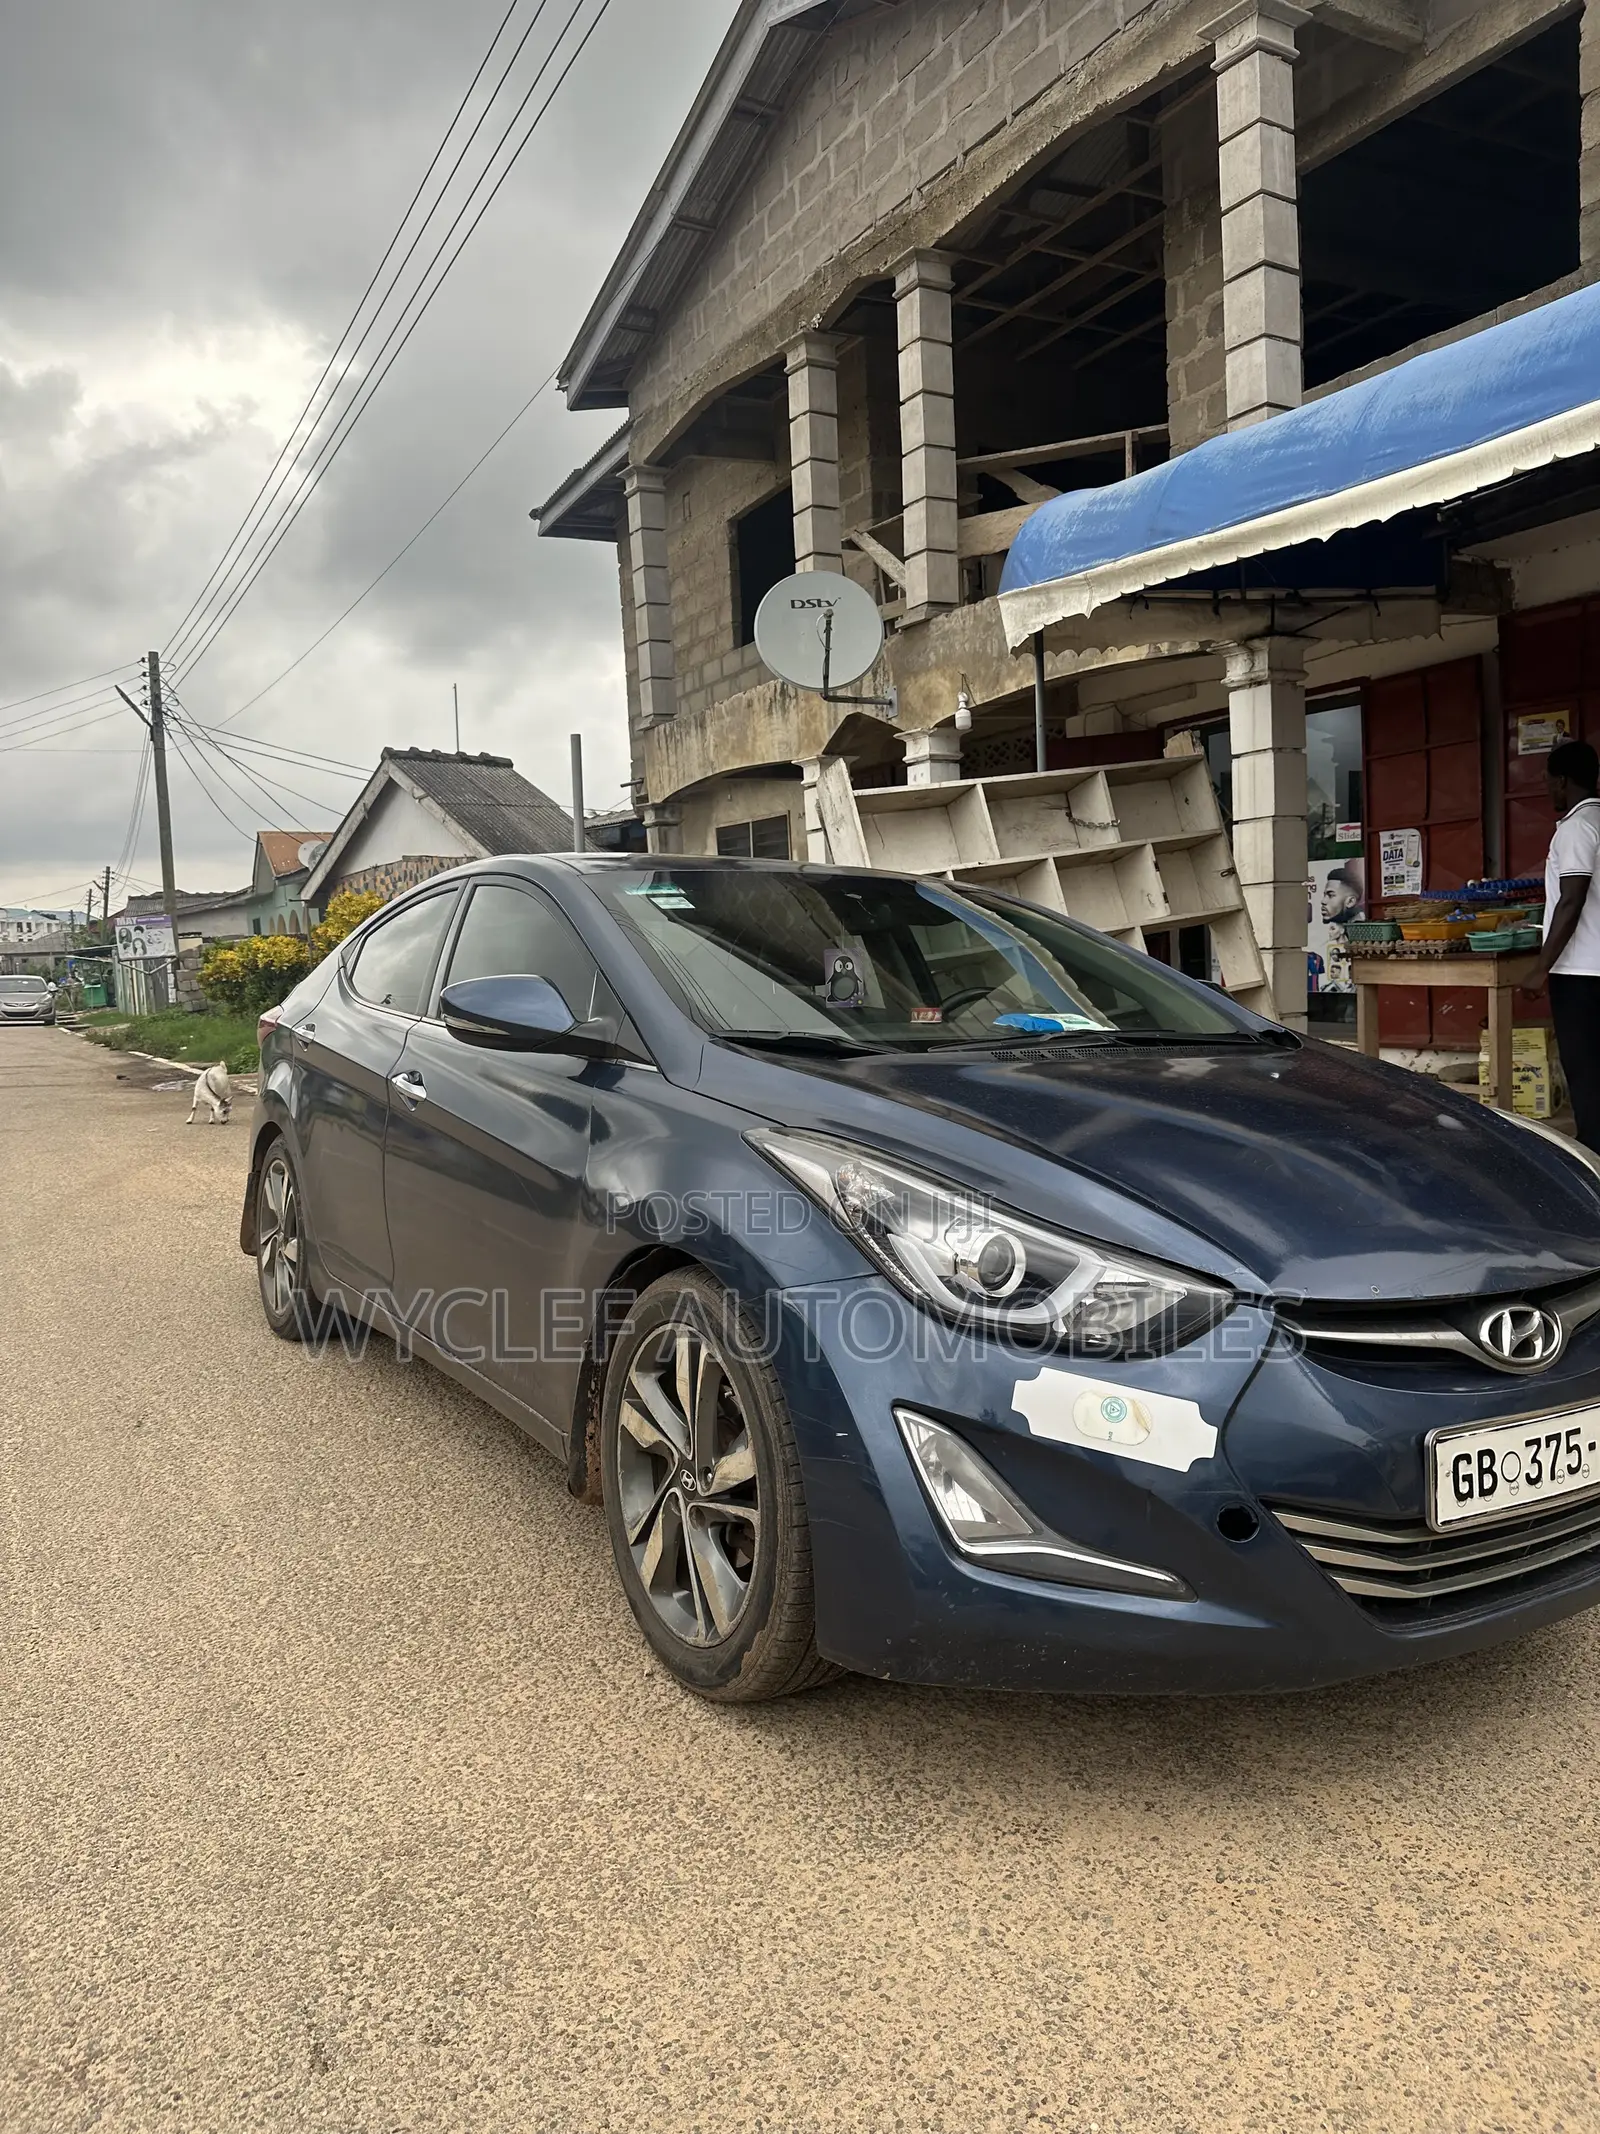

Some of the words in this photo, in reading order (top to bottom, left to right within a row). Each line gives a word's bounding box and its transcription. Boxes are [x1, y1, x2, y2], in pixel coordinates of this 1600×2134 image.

[1338, 831, 1361, 841] Slide
[1383, 848, 1404, 861] DATA
[1452, 1448, 1499, 1503] GB
